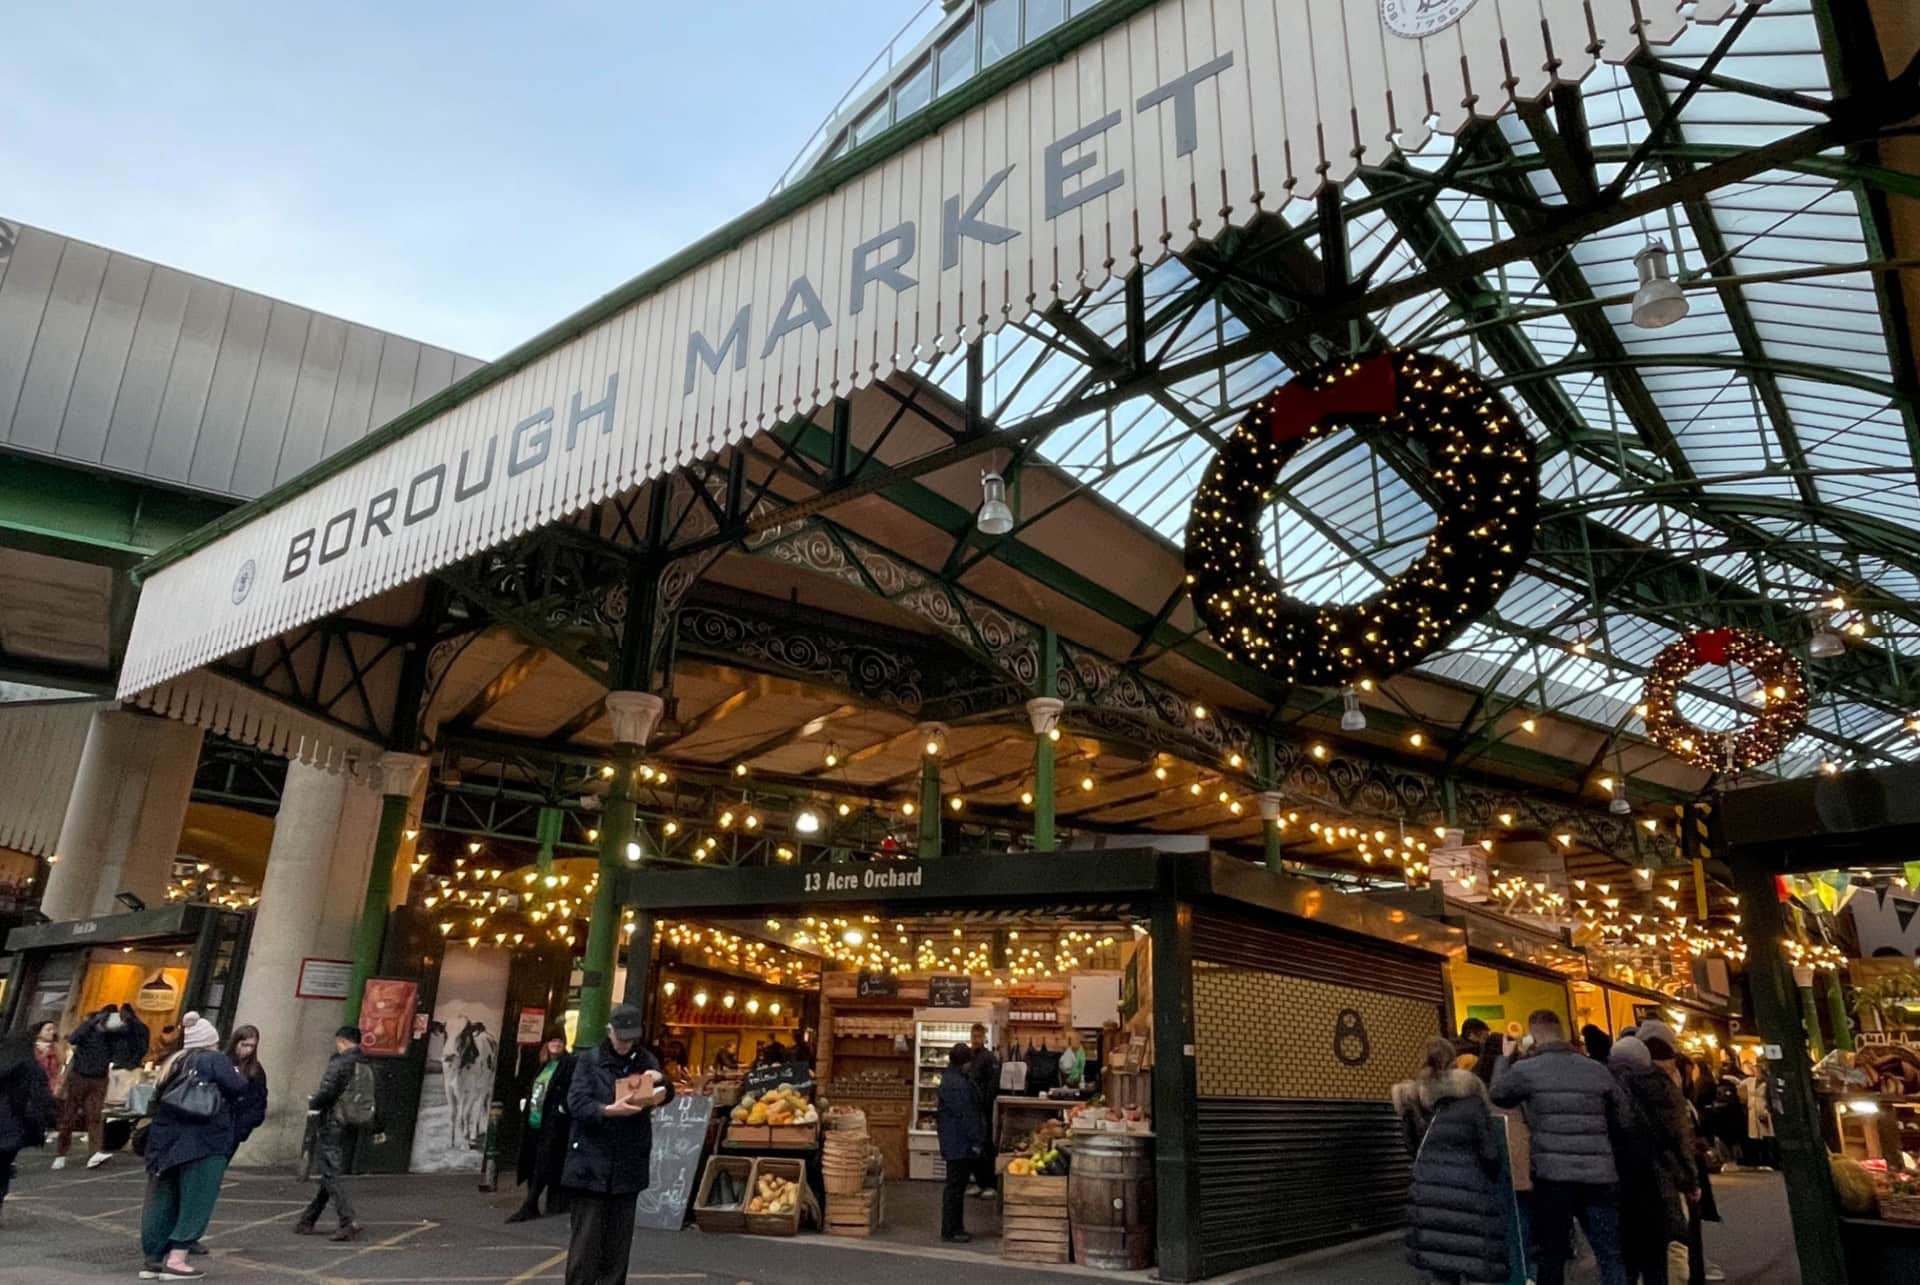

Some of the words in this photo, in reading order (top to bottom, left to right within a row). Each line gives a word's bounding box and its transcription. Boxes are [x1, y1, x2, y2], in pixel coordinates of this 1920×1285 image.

[281, 371, 621, 584] BOROUGH
[683, 50, 1234, 397] MARKET
[804, 872, 822, 892] 13
[826, 871, 859, 891] Acre
[864, 866, 923, 889] Orchard
